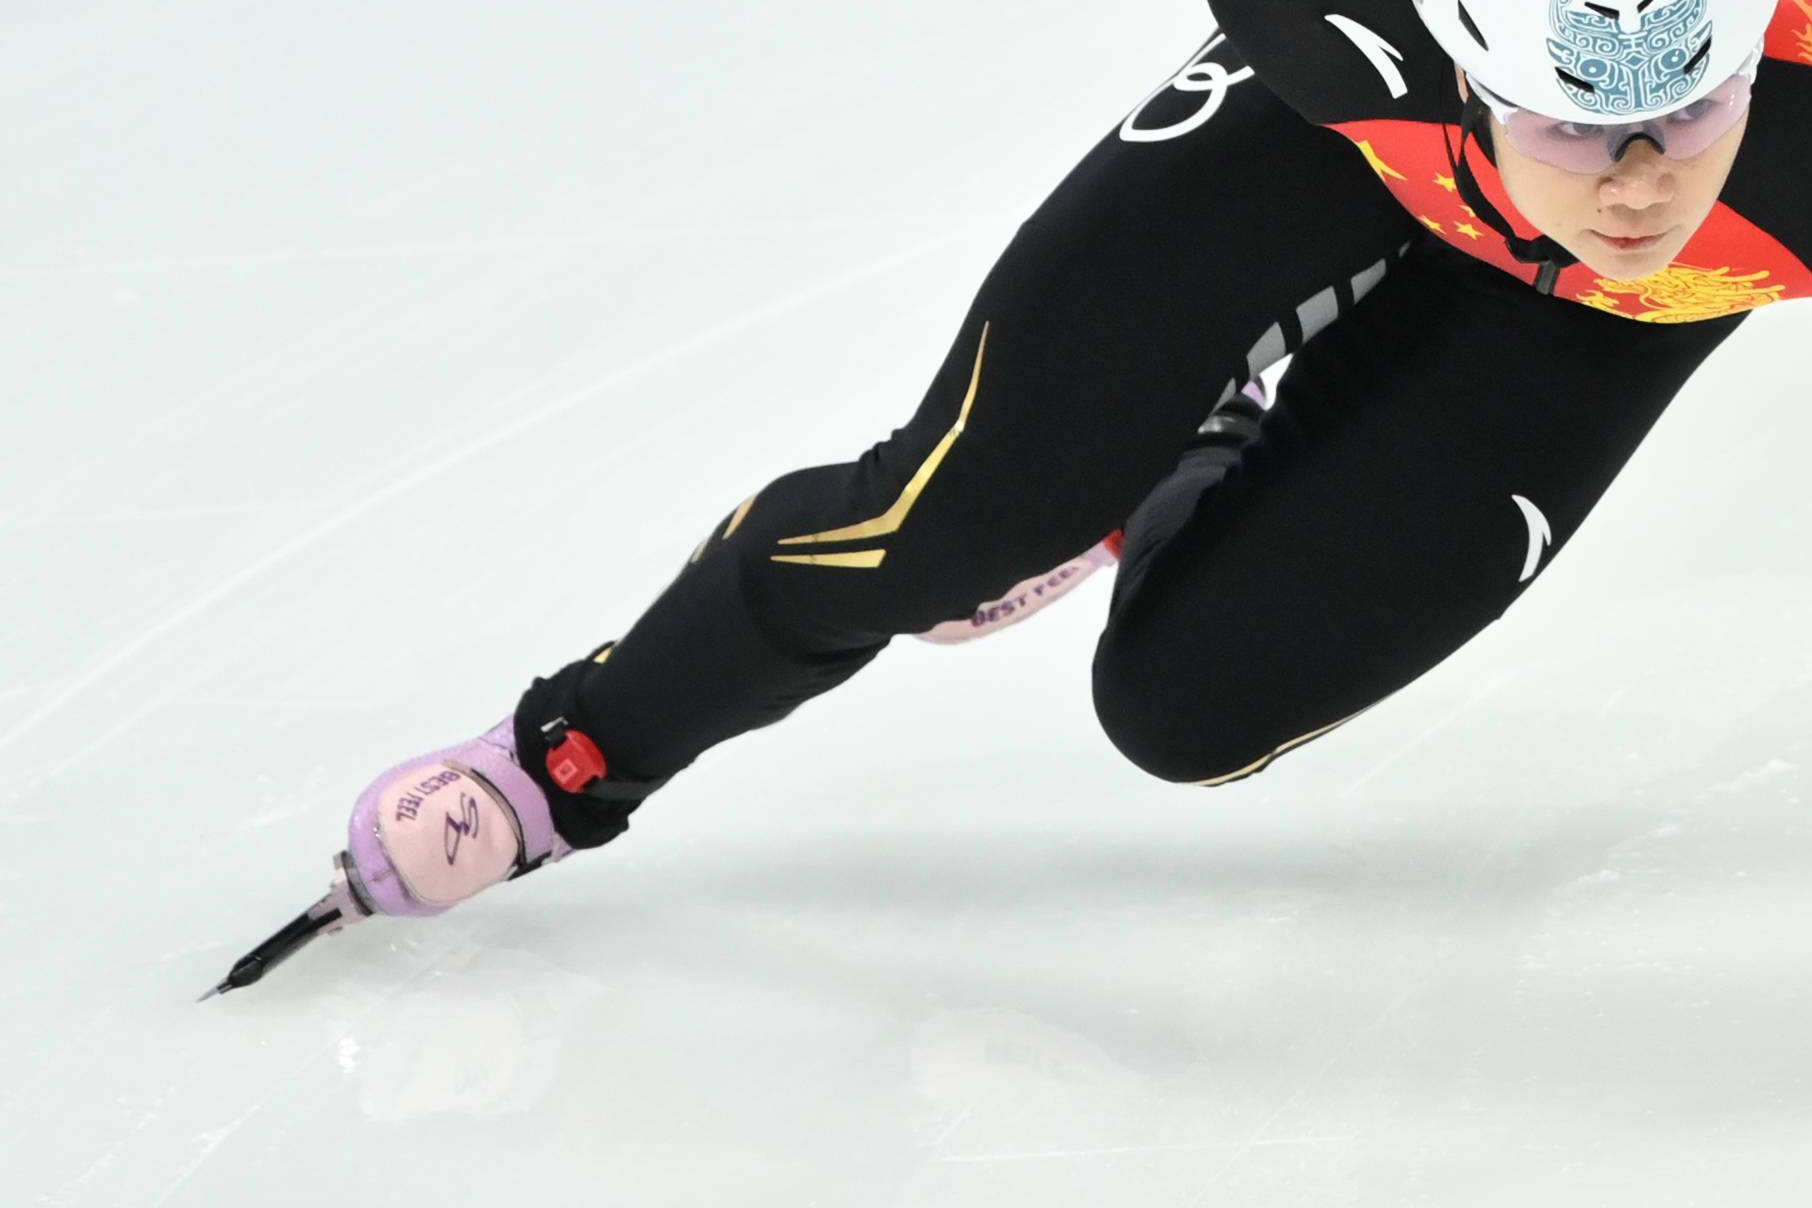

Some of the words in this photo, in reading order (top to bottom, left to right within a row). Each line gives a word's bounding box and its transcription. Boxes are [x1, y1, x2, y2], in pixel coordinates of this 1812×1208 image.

[971, 594, 1027, 627] BEST
[414, 771, 461, 795] BEST
[396, 791, 424, 822] FEEL
